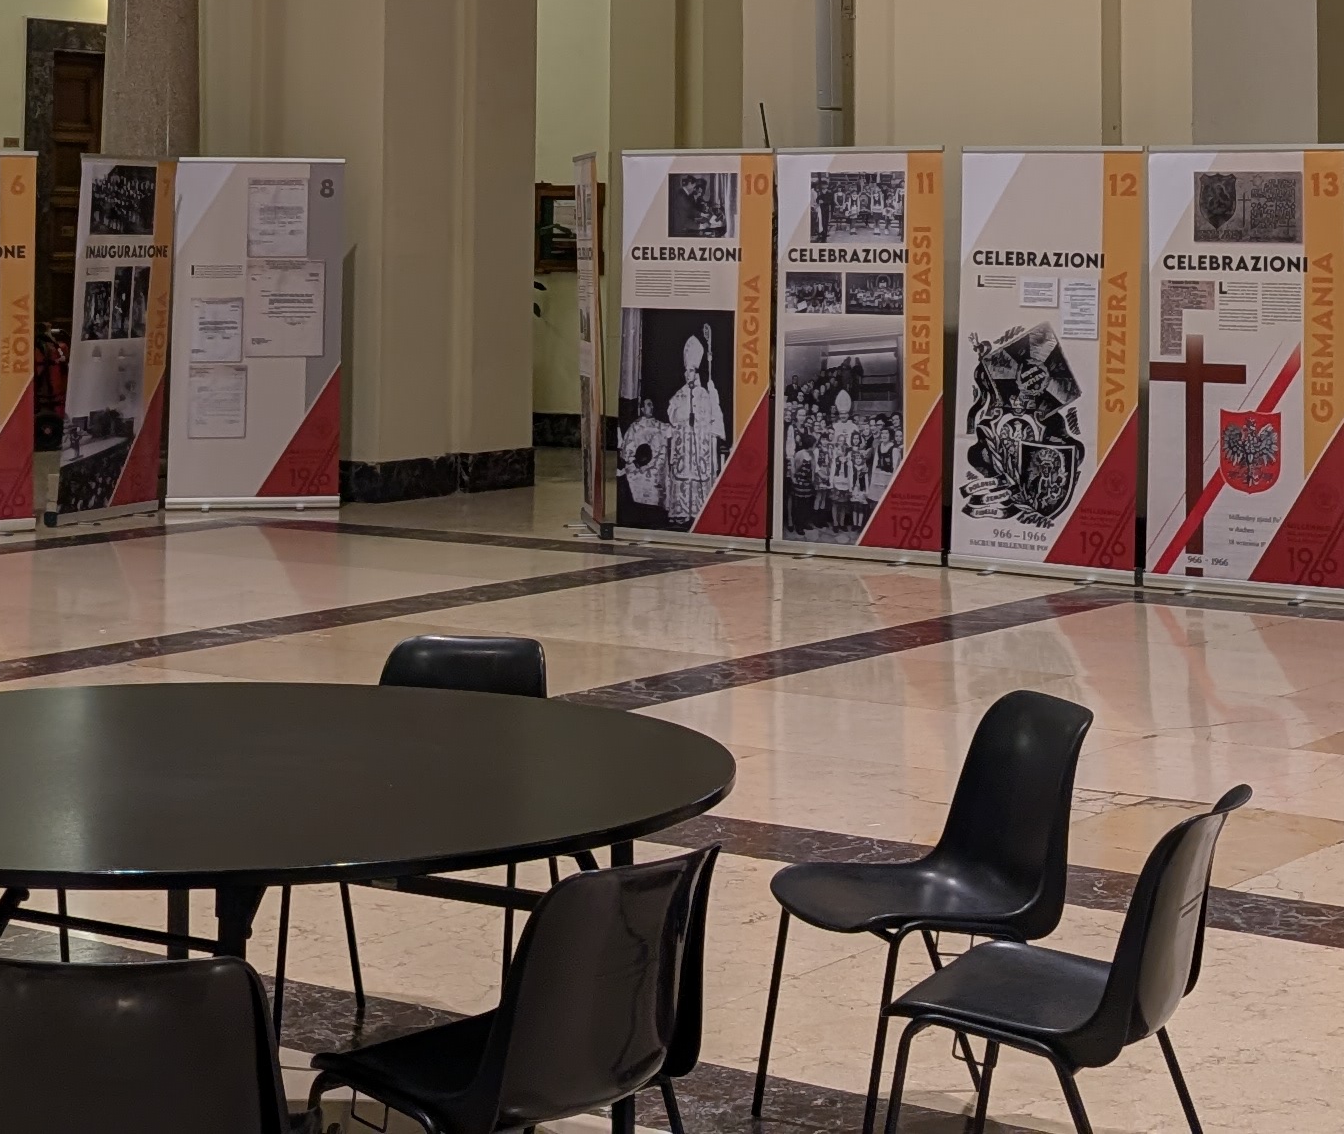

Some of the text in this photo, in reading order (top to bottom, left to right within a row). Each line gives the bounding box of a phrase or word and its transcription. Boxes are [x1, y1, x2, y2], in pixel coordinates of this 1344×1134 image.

[11, 175, 25, 195] 6
[163, 179, 171, 197] 7
[319, 179, 335, 198] 8
[744, 174, 770, 196] 10
[917, 172, 934, 194] 11
[1109, 173, 1137, 197] 12
[1311, 172, 1339, 197] 13
[86, 245, 168, 259] INAUGURAZIONE
[631, 247, 742, 262] CELEBRAZIONI
[788, 248, 909, 263] CELEBRAZIONI
[973, 250, 1105, 269] CELEBRAZIONI
[1163, 255, 1308, 272] CELEBRAZIONI
[977, 275, 985, 287] L
[1219, 282, 1227, 295] L
[911, 226, 932, 391] PAESI BASSI
[12, 294, 30, 374] ROMA
[152, 292, 167, 366] ROMA
[741, 275, 760, 385] SPAGNA
[1311, 253, 1334, 423] GERMANIA
[1106, 271, 1127, 413] SVIZZERA
